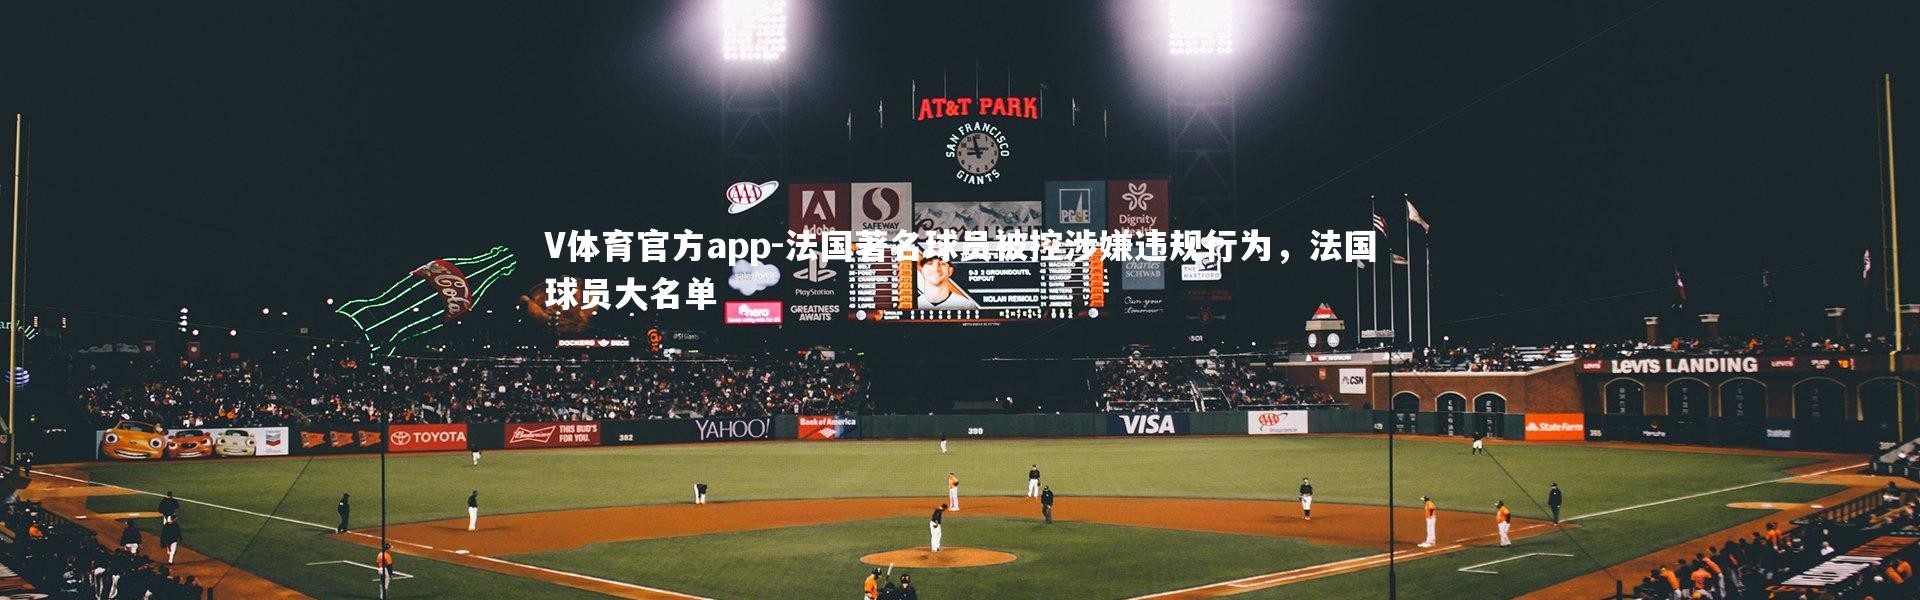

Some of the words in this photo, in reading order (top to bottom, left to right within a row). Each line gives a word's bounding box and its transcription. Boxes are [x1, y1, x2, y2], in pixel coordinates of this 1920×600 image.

[918, 97, 972, 120] AT&T
[979, 96, 1039, 119] PARK
[945, 133, 960, 158] SAN
[957, 121, 1010, 157] FRANCISCO
[956, 169, 1001, 185] GIANTS
[729, 184, 761, 204] AAA
[1059, 209, 1090, 222] PG&E
[1119, 214, 1157, 227] Dignity
[862, 222, 900, 230] SAFEWAY
[1121, 227, 1154, 237] Healt
[1125, 258, 1161, 270] charles
[734, 271, 774, 282] salesforce
[1125, 270, 1162, 278] SCHWAB
[434, 274, 471, 316] Cola
[795, 288, 835, 297] PlayStation
[1007, 295, 1039, 303] REIMOLD
[1124, 296, 1142, 305] Own
[1143, 299, 1163, 308] your
[790, 305, 840, 313] GREATNESS
[799, 313, 832, 321] AWAITS
[1665, 357, 1759, 373] LANDING
[1349, 375, 1364, 385] CSN
[800, 418, 818, 426] Bank
[818, 418, 827, 426] of
[827, 418, 857, 426] America
[1118, 414, 1176, 434] VISA
[1538, 422, 1561, 432] State
[1561, 422, 1584, 432] Farm
[513, 429, 552, 439] Budweiser
[559, 424, 576, 433] THIS
[576, 424, 598, 433] BUD'S
[695, 418, 771, 441] YAHOO!
[412, 431, 467, 443] TOYOTA
[559, 434, 574, 442] FOR
[575, 433, 590, 442] YOU.
